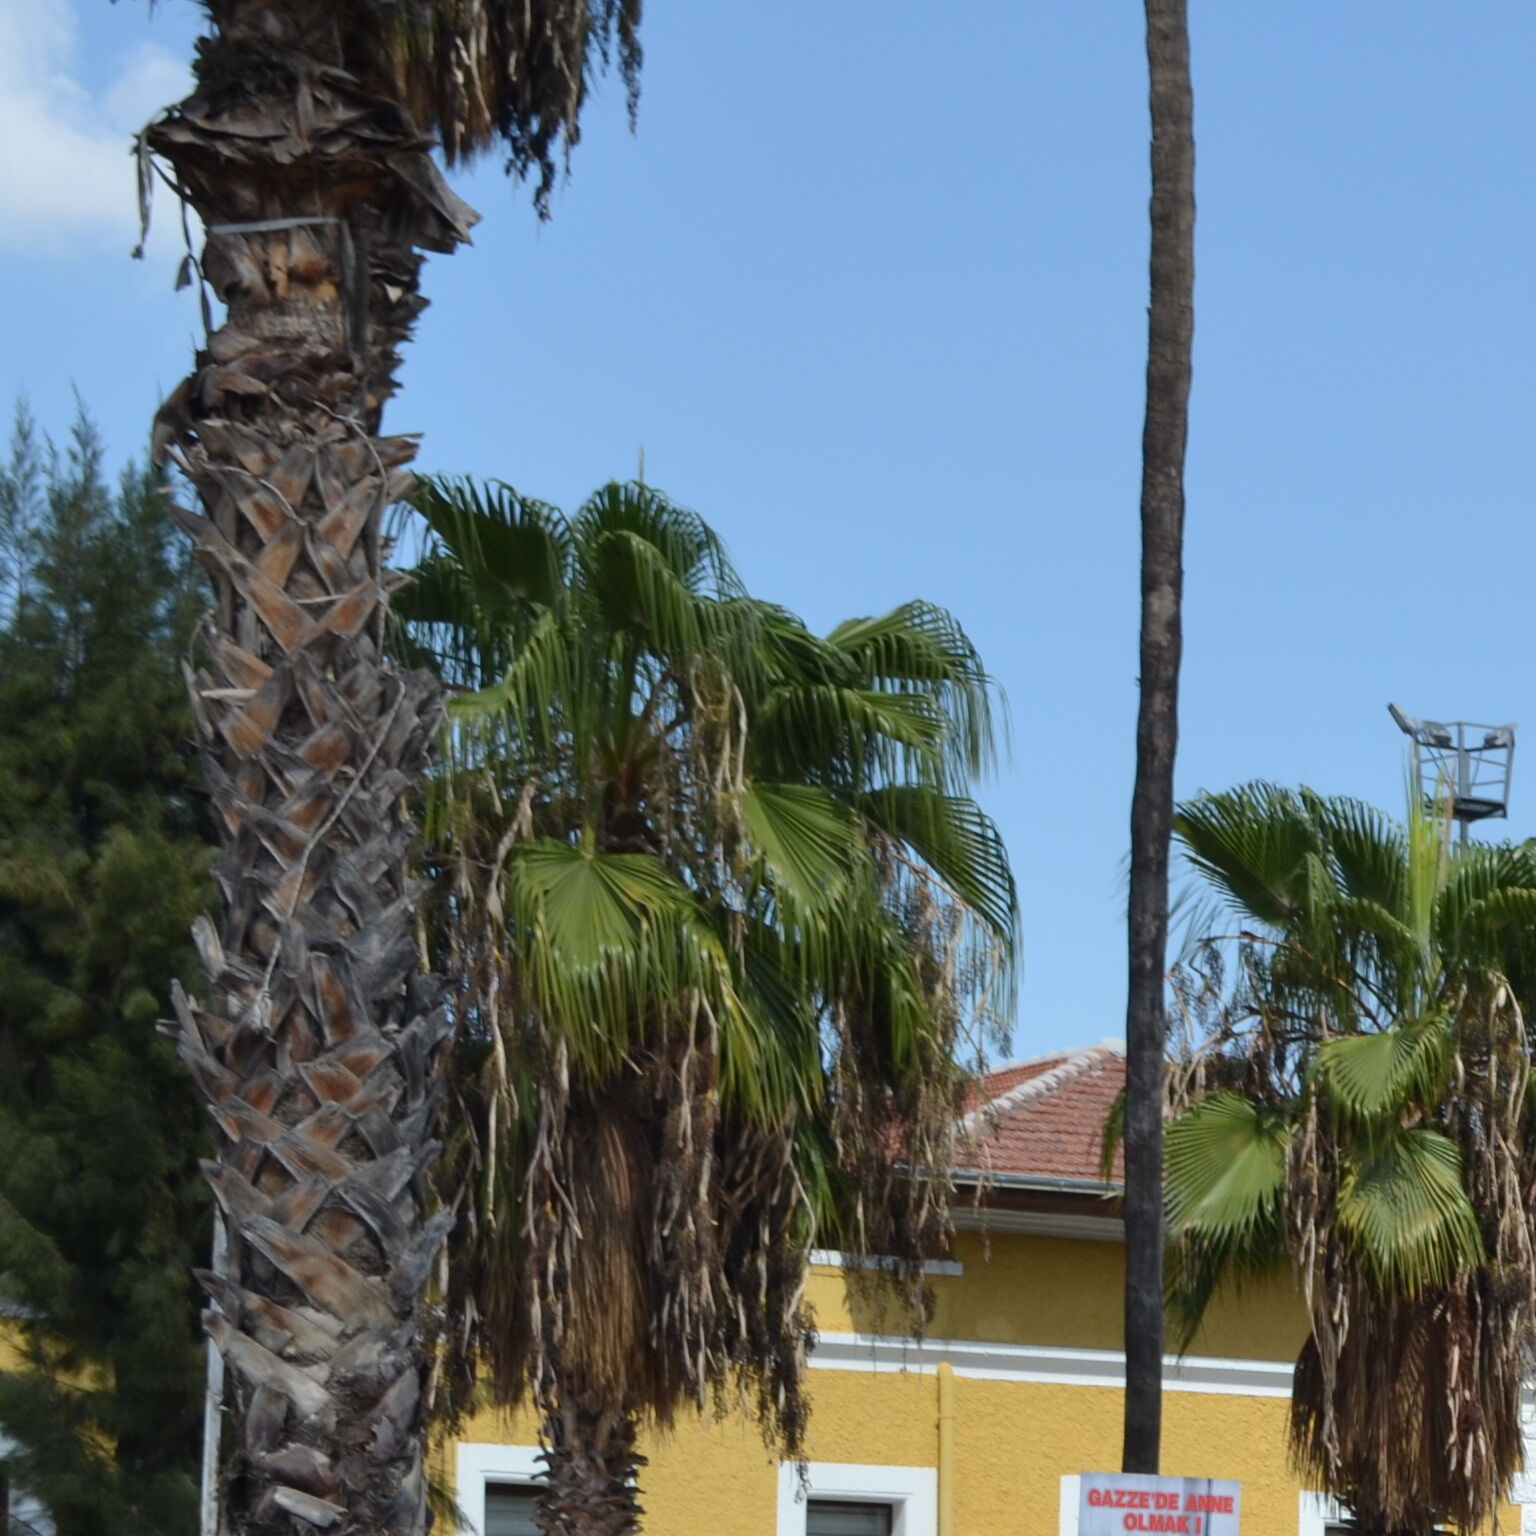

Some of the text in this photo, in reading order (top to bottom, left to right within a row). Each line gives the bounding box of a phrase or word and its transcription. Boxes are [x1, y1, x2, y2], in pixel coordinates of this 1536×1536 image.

[1087, 1488, 1234, 1514] GAZZE'DE ANNE
[1123, 1513, 1190, 1534] OLMAK
